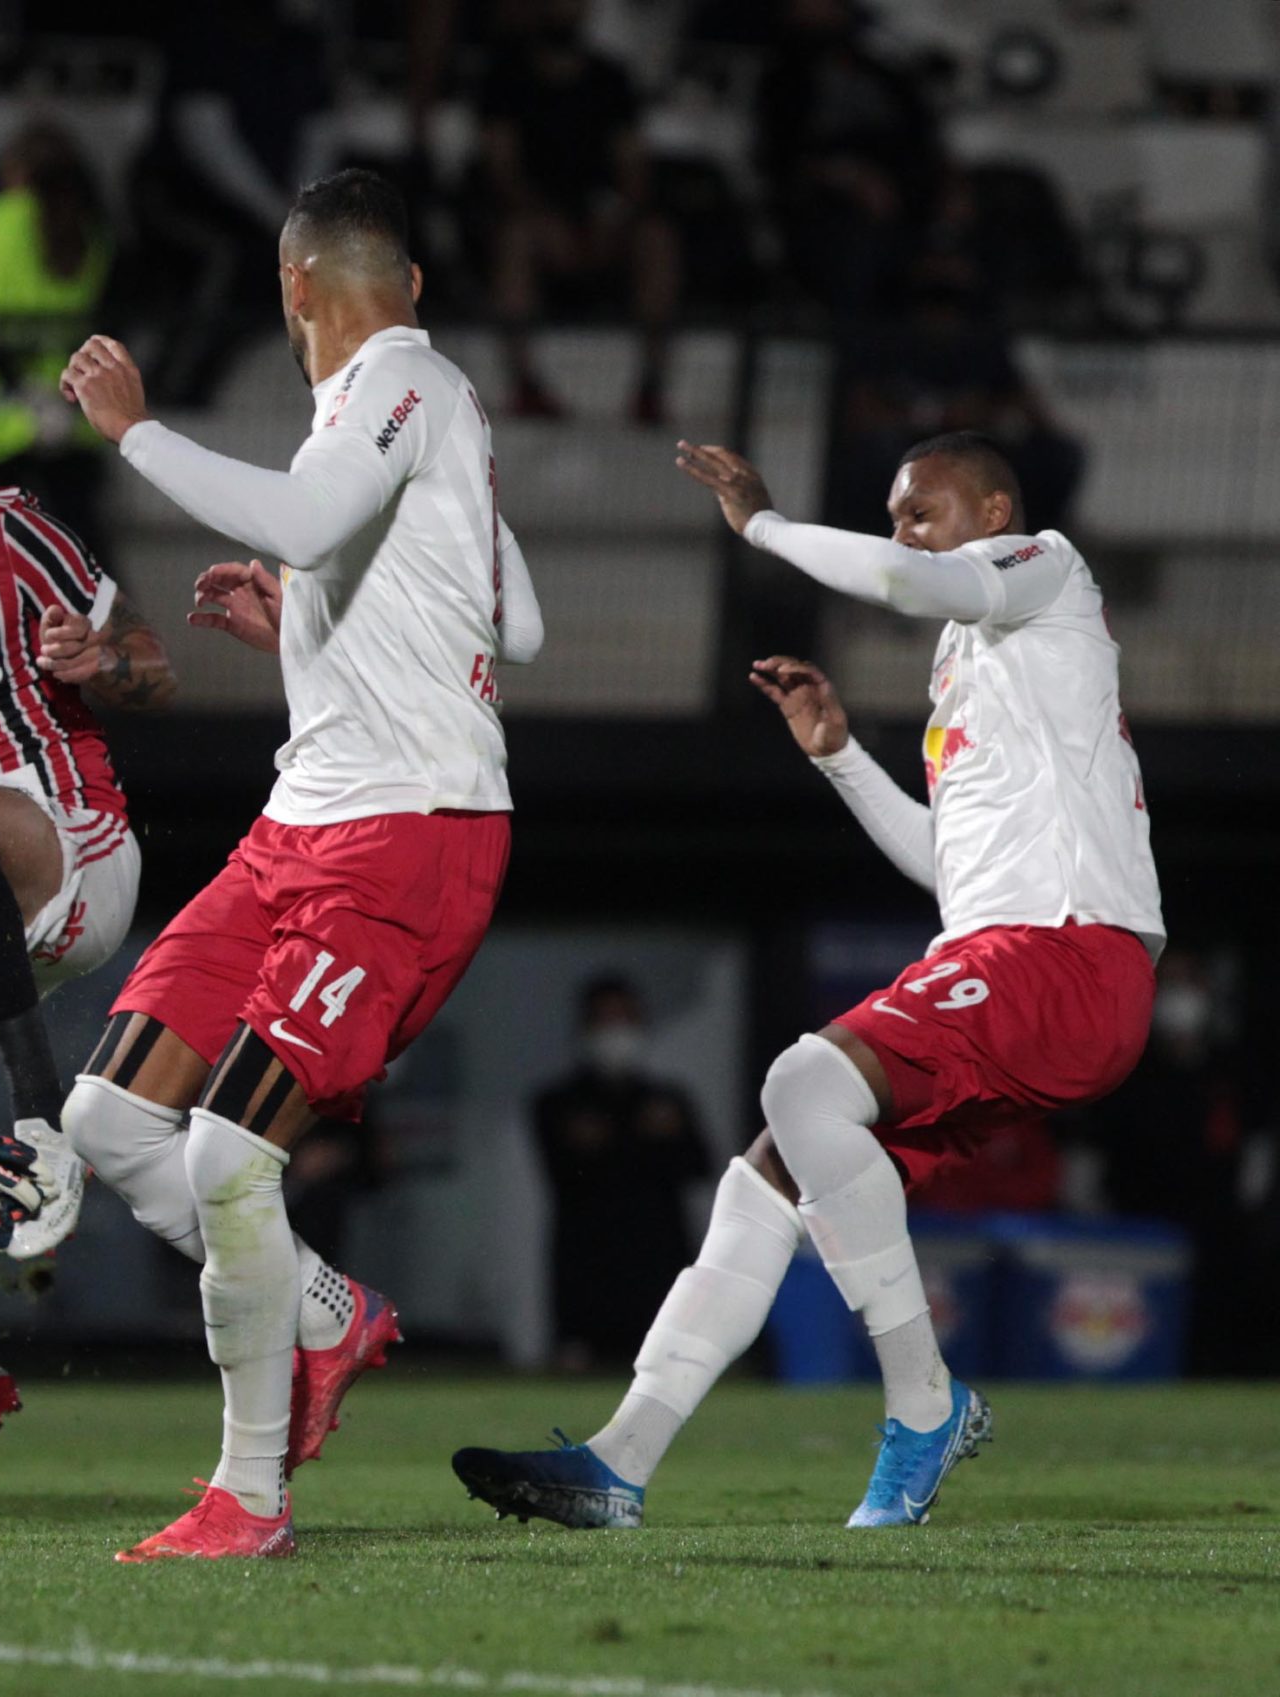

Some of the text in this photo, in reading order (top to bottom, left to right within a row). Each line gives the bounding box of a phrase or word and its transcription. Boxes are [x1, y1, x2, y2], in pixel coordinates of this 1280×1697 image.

[374, 388, 422, 456] NetBet
[991, 544, 1045, 571] NetBet
[470, 653, 502, 704] FA
[288, 949, 367, 1028] 14
[902, 961, 990, 1010] 29
